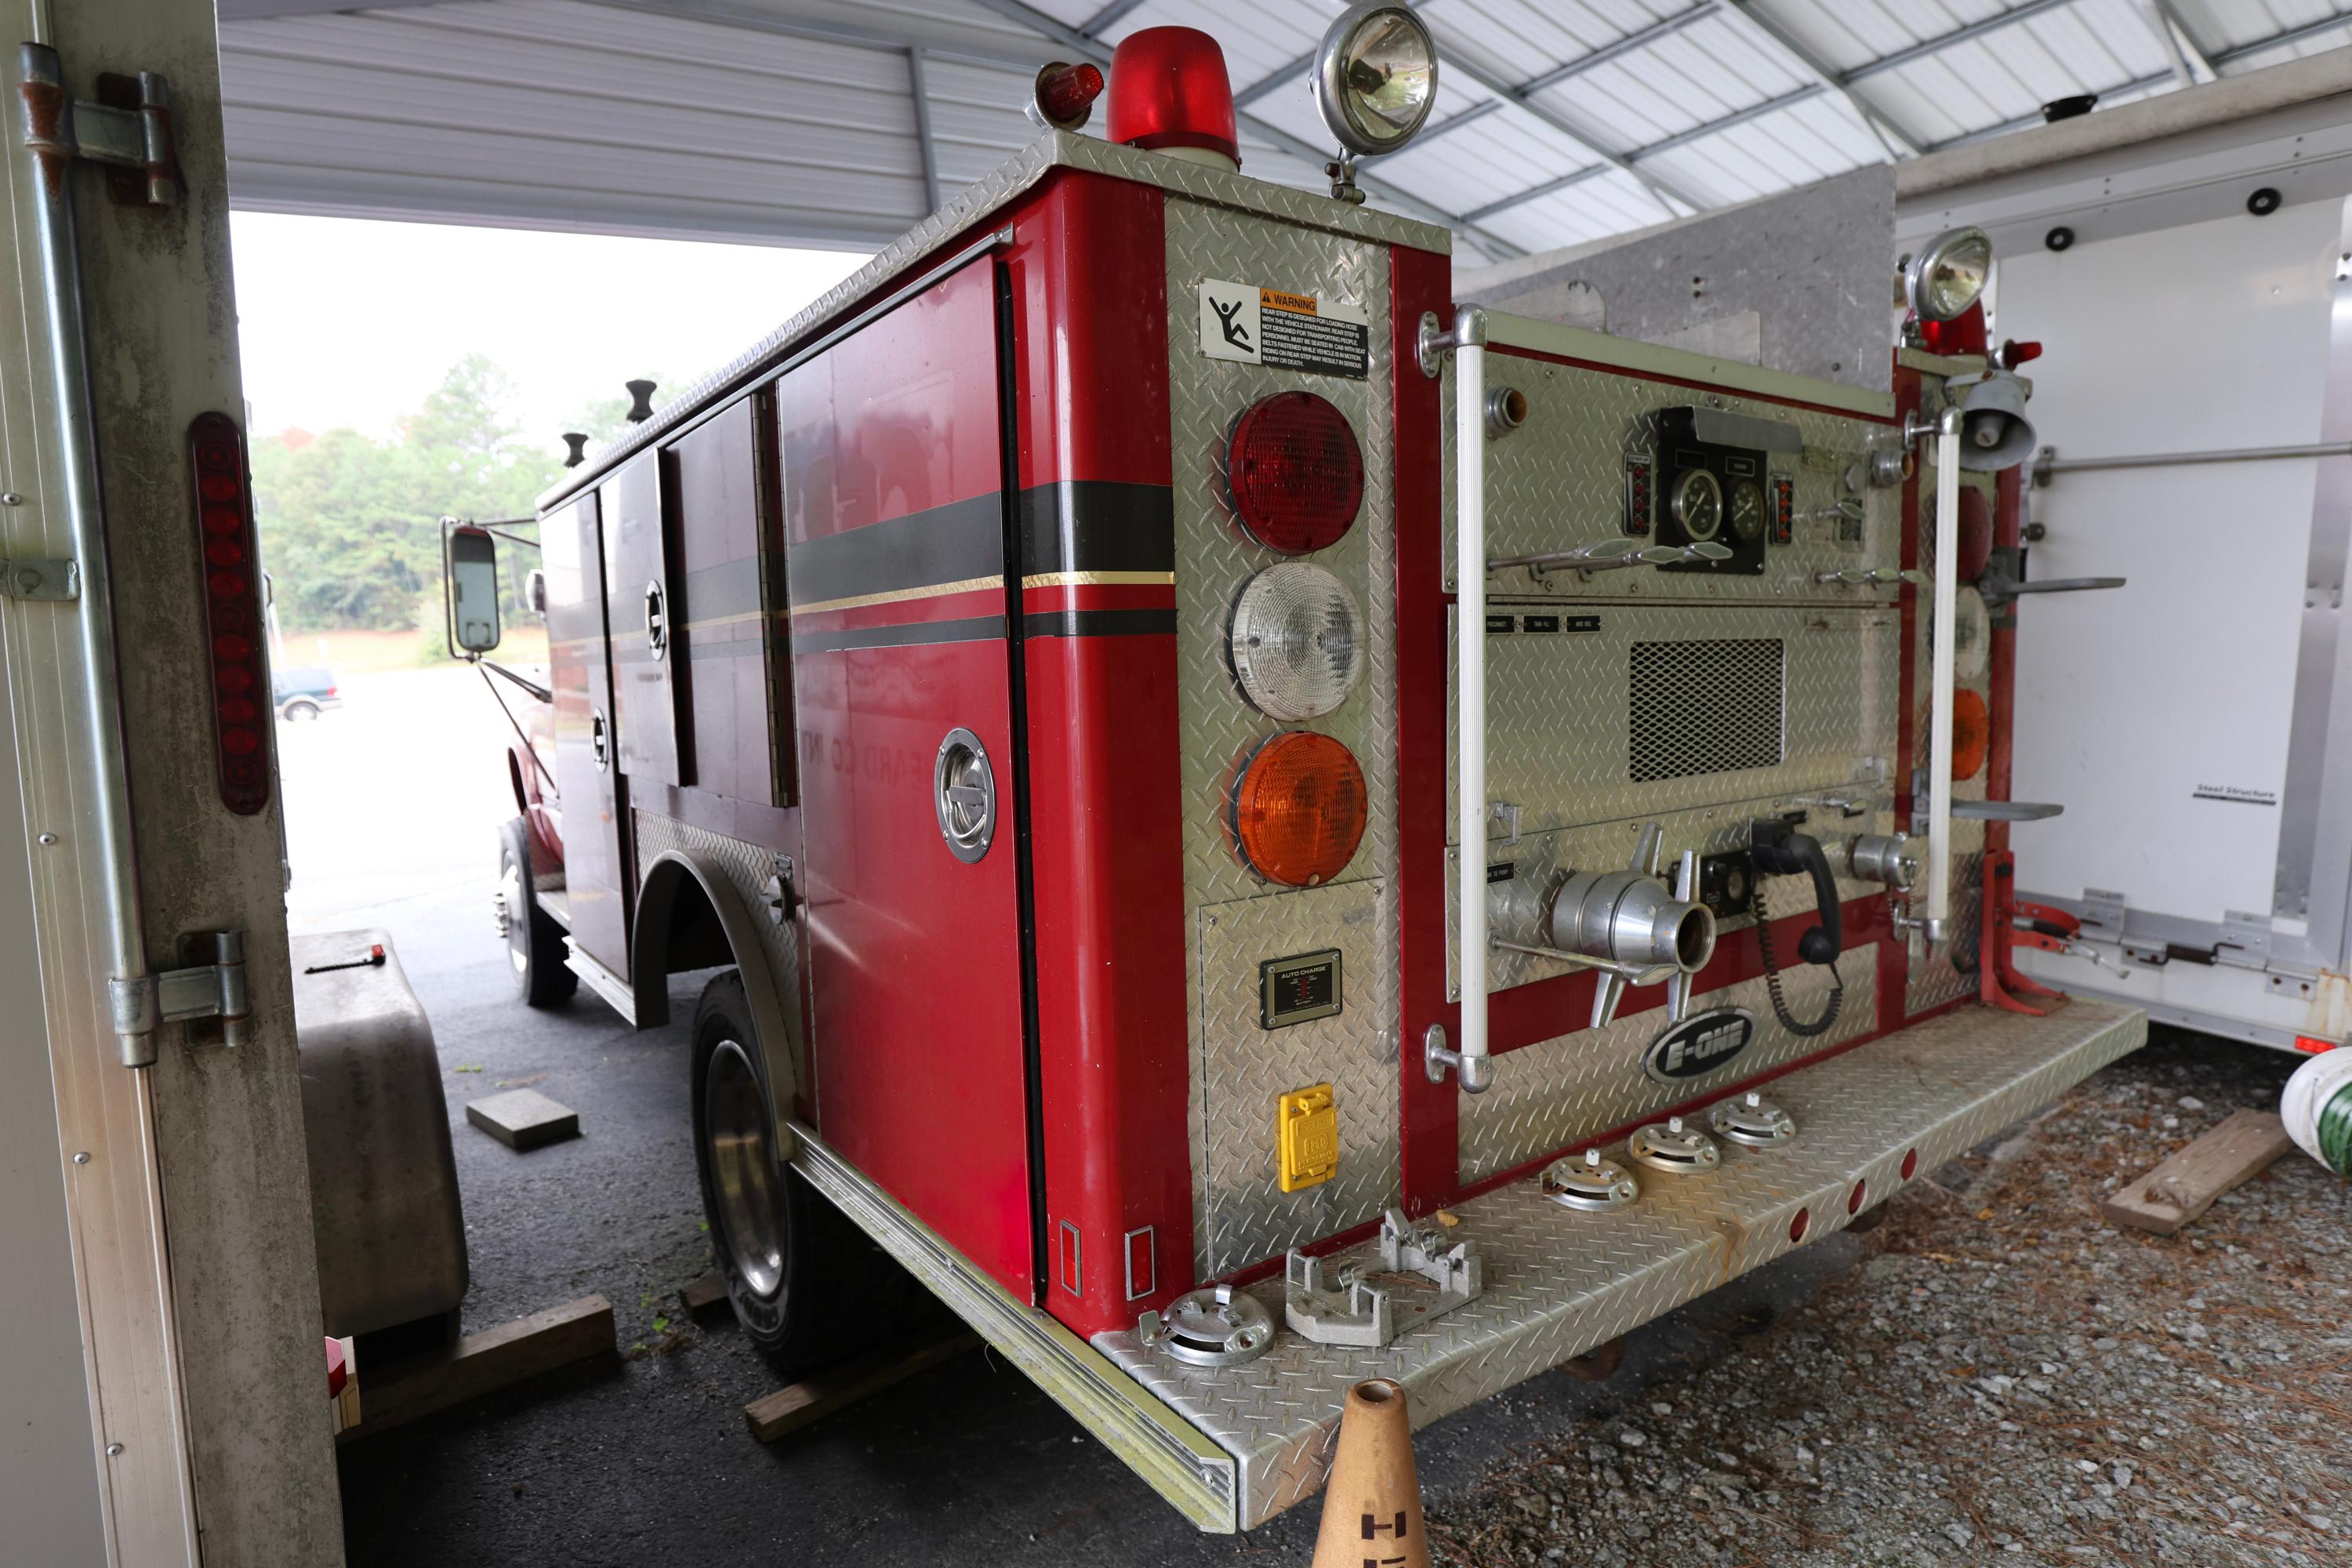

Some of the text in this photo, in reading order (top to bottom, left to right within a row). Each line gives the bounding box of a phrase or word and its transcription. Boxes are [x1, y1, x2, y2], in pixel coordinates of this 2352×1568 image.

[1274, 294, 1316, 311] WARNING
[1284, 319, 1303, 328] VEHICLE
[1293, 313, 1316, 322] DESIGNED
[1326, 319, 1345, 328] LOADING
[1261, 331, 1290, 341] PERSONNEL
[1272, 325, 1296, 334] DESIGNED
[1306, 331, 1340, 342] TRANSPORTING
[1277, 341, 1301, 350] FASTENED
[1322, 356, 1338, 365] RESULT
[1343, 360, 1361, 368] SERIOUS
[2198, 783, 2275, 798] Steel Structure
[1300, 966, 1326, 975] CHARGE
[1664, 1019, 1744, 1072] E-ONE
